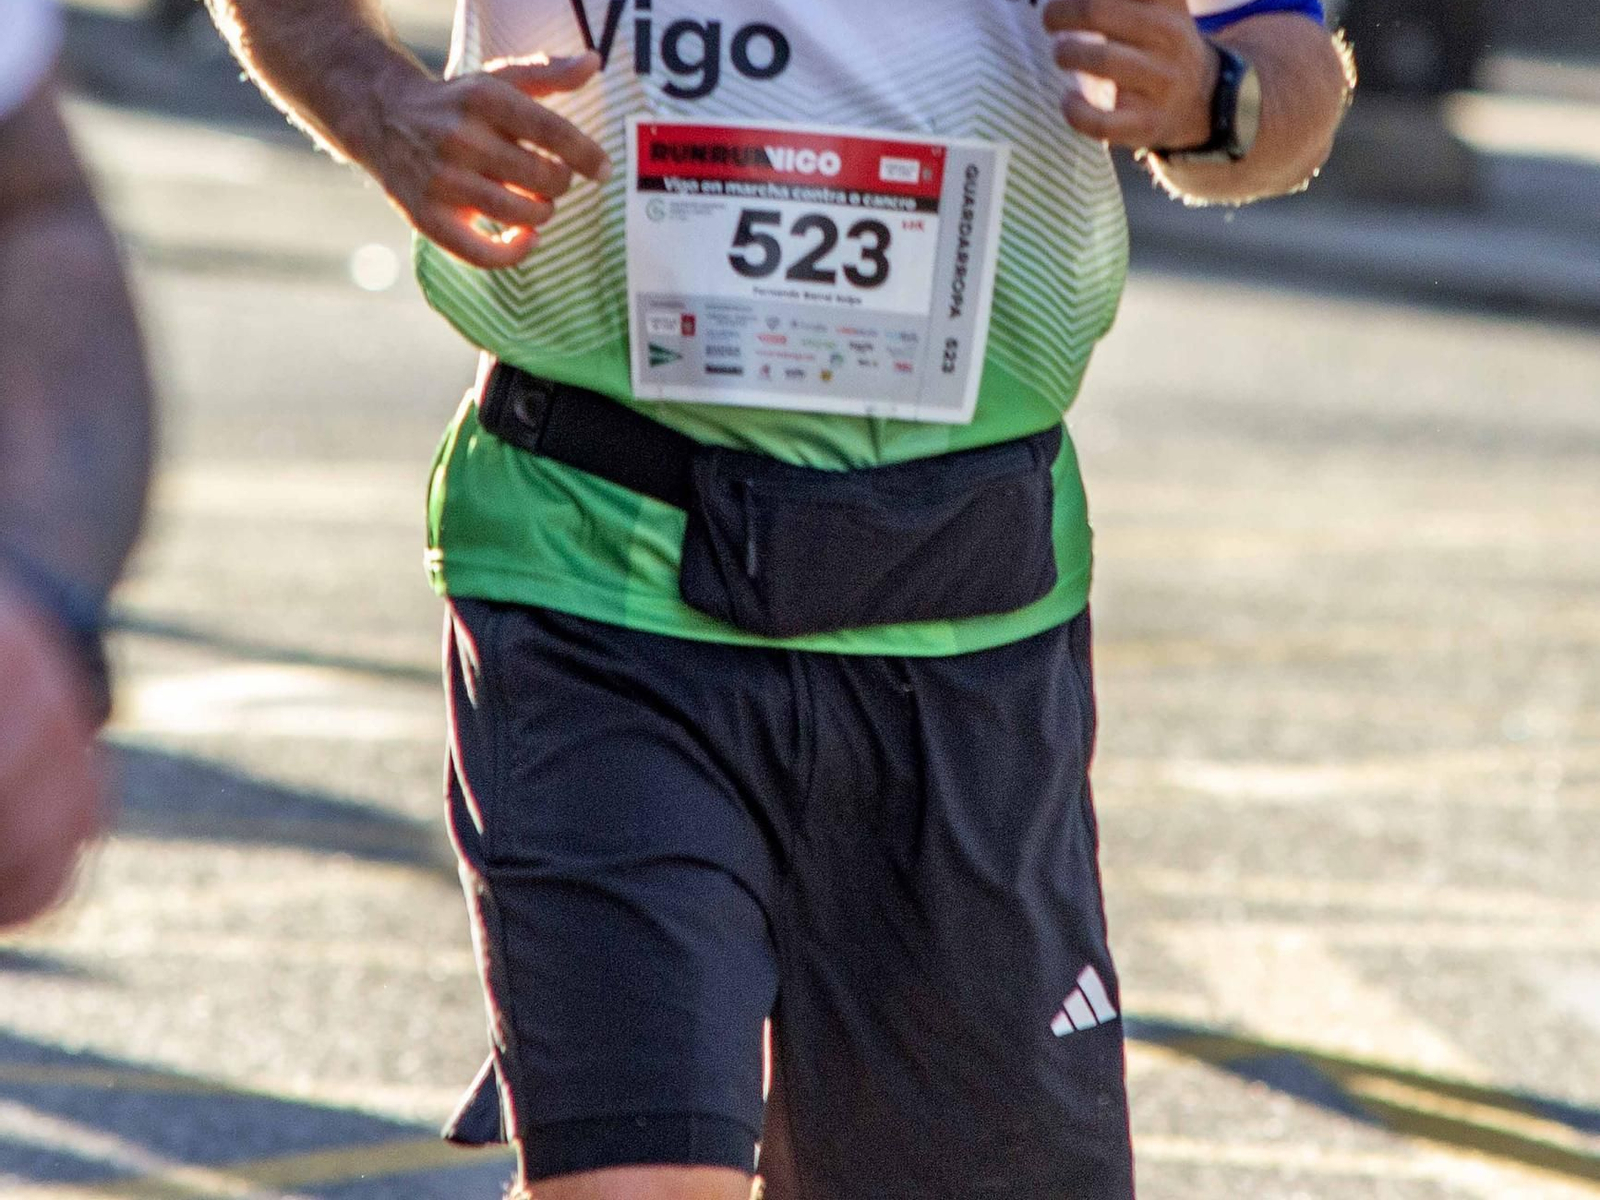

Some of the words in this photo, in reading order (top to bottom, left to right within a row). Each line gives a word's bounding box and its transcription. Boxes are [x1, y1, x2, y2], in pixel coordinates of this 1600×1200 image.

[727, 208, 892, 289] 523
[949, 162, 979, 319] GUARDARROPA
[941, 337, 959, 375] 523
